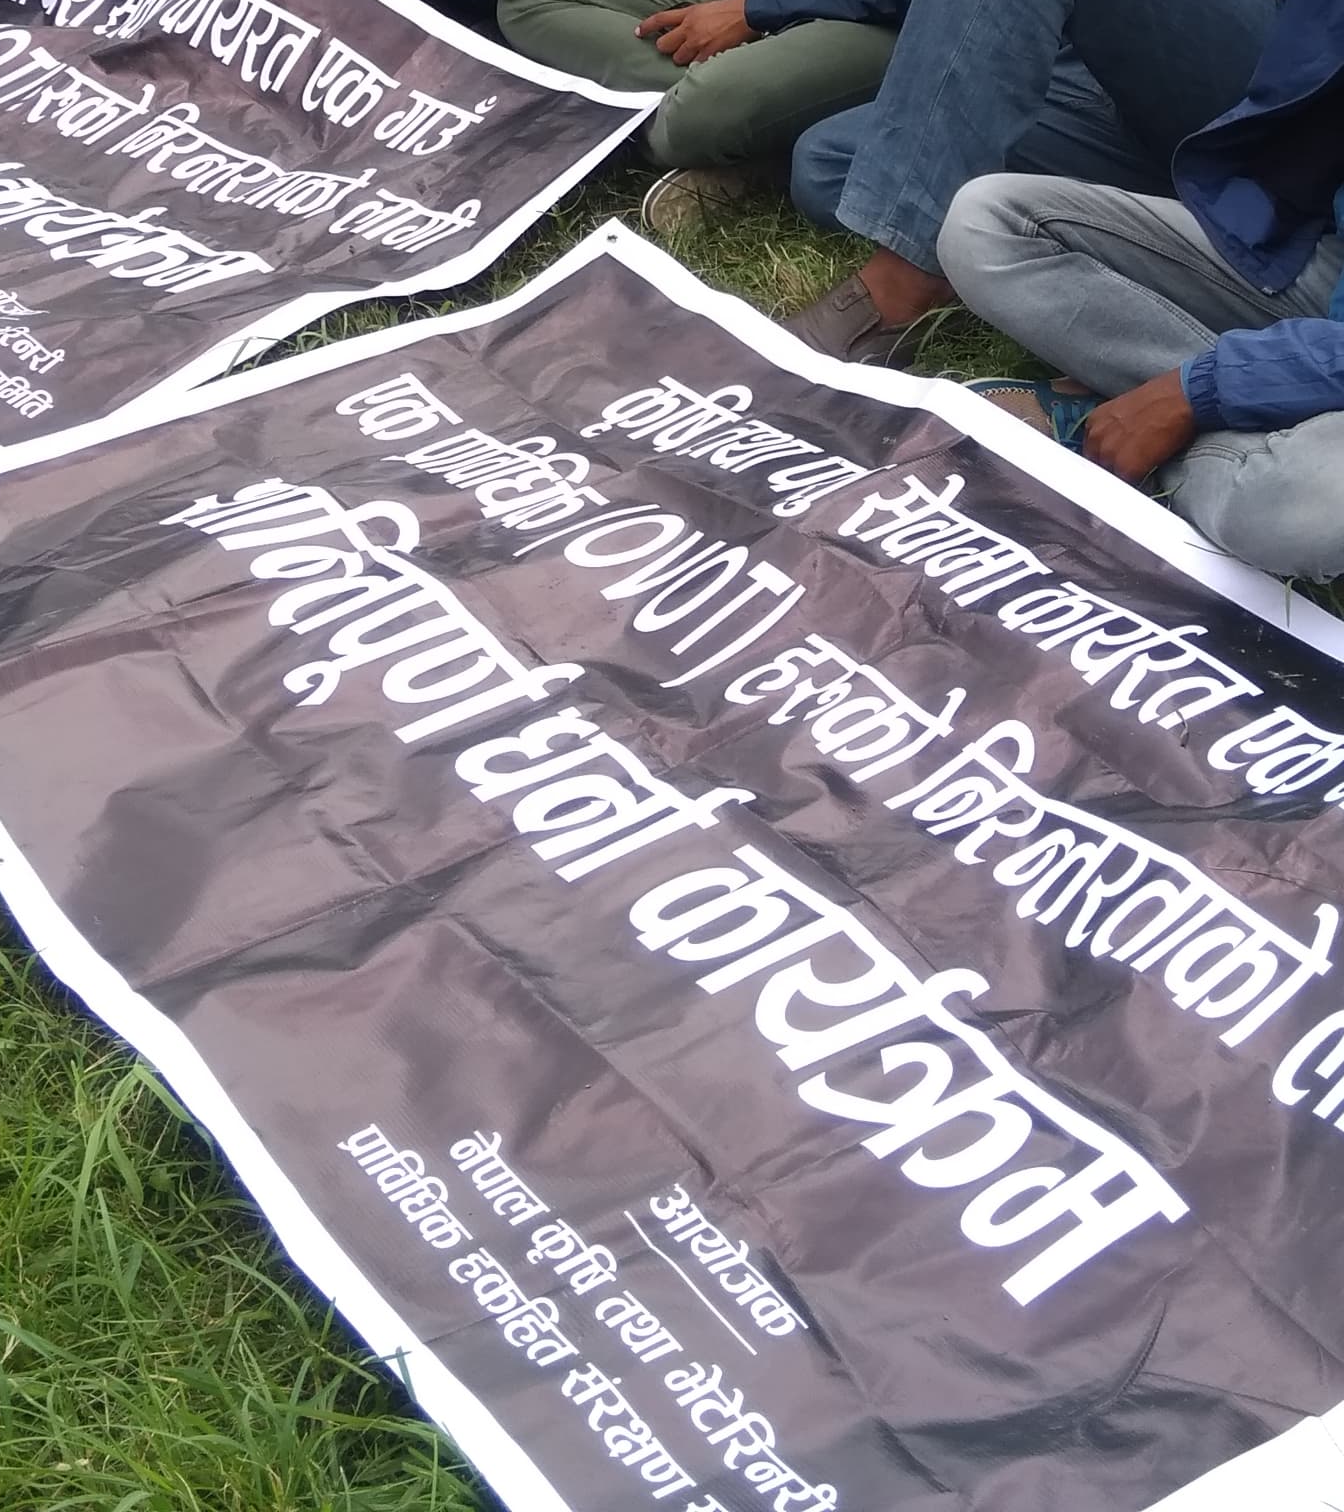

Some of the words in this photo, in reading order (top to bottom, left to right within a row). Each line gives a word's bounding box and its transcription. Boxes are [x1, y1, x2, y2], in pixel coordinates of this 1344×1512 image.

[301, 37, 402, 130] एक
[334, 371, 465, 442] एक
[837, 473, 1054, 608] सेवामा
[997, 579, 1264, 732] कार्यरत
[156, 476, 588, 745] शान्तिपूर्ण
[627, 842, 1194, 1309] कार्यक्रम
[336, 1122, 474, 1251] प्राविधिक
[447, 1246, 581, 1368] हकहित
[560, 1361, 698, 1501] संरक्षण
[448, 1128, 551, 1227] नेपाल
[525, 1217, 619, 1297] कृषि
[593, 1289, 684, 1365] तथा
[648, 1182, 810, 1338] आयोजक
